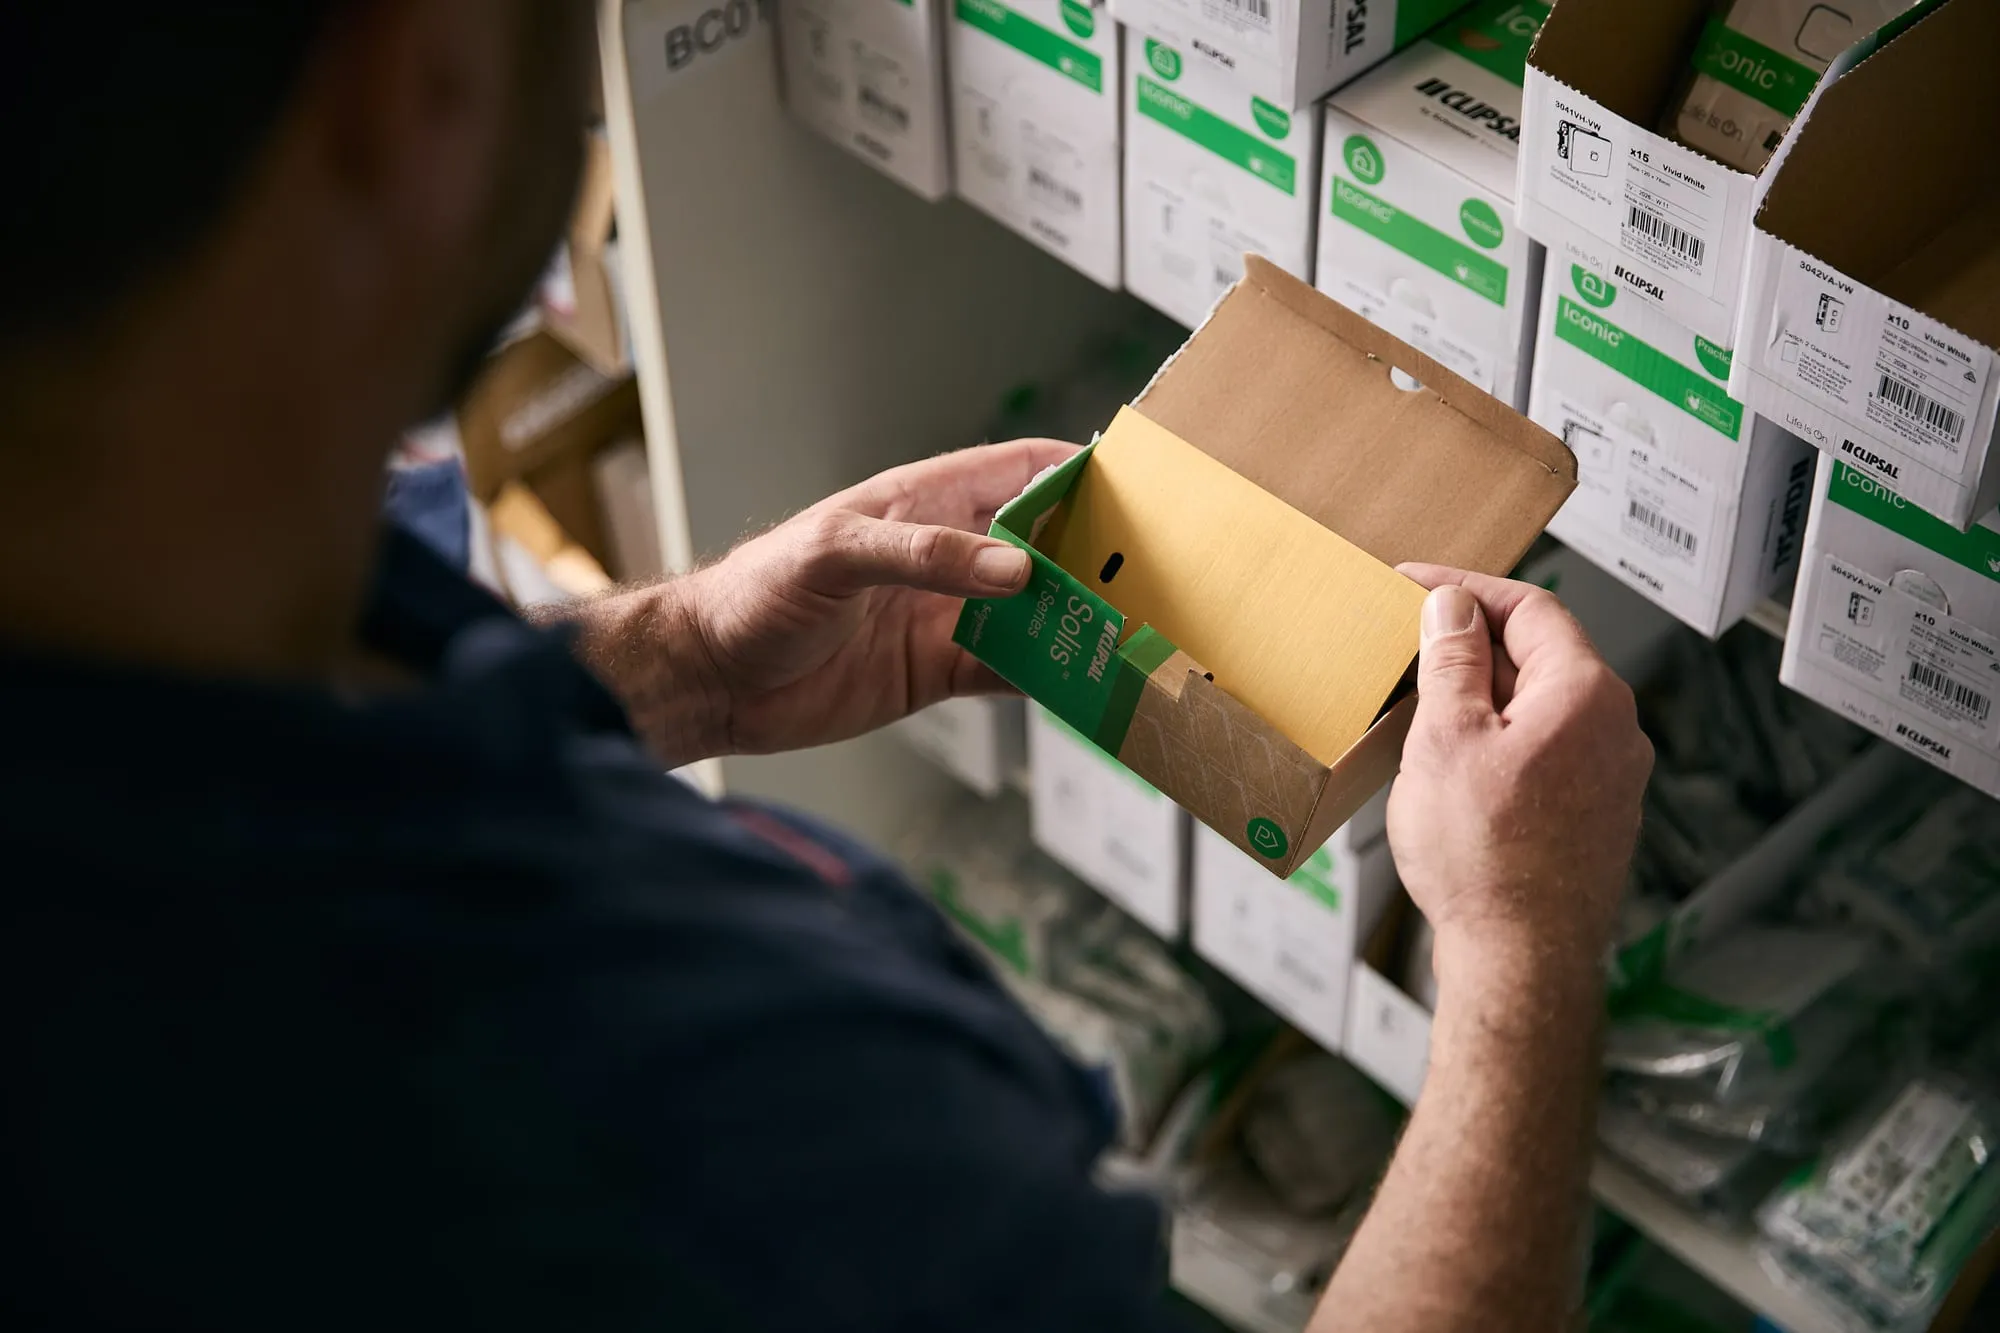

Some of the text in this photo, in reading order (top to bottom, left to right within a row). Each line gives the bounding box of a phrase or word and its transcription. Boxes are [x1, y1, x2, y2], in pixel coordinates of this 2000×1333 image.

[664, 0, 770, 72] BC0
[1344, 0, 1368, 56] SAL
[1441, 90, 1520, 146] CLIPSA
[1554, 99, 1601, 132] 3041VH-VW
[1629, 146, 1649, 164] x15
[1662, 163, 1706, 191] Vivid White
[1624, 271, 1665, 301] CLIPSAL
[1799, 259, 1853, 296] 3042VA-VW
[1563, 301, 1620, 348] Iconic
[1887, 311, 1909, 330] x10
[1698, 338, 1732, 365] Practic
[1923, 332, 1945, 349] Vivid
[1946, 344, 1972, 364] White
[1786, 413, 1829, 445] Life Is On
[1853, 446, 1899, 480] CLIPSAL
[1841, 464, 1906, 509] Iconic
[1027, 579, 1060, 639] T Series
[1914, 610, 1936, 627] x10
[1050, 595, 1093, 666] Solis
[1949, 628, 1970, 644] Vivid
[1971, 638, 1995, 656] White
[1087, 634, 1115, 683] CLIPSAL
[1907, 727, 1951, 759] CLIPSAL
